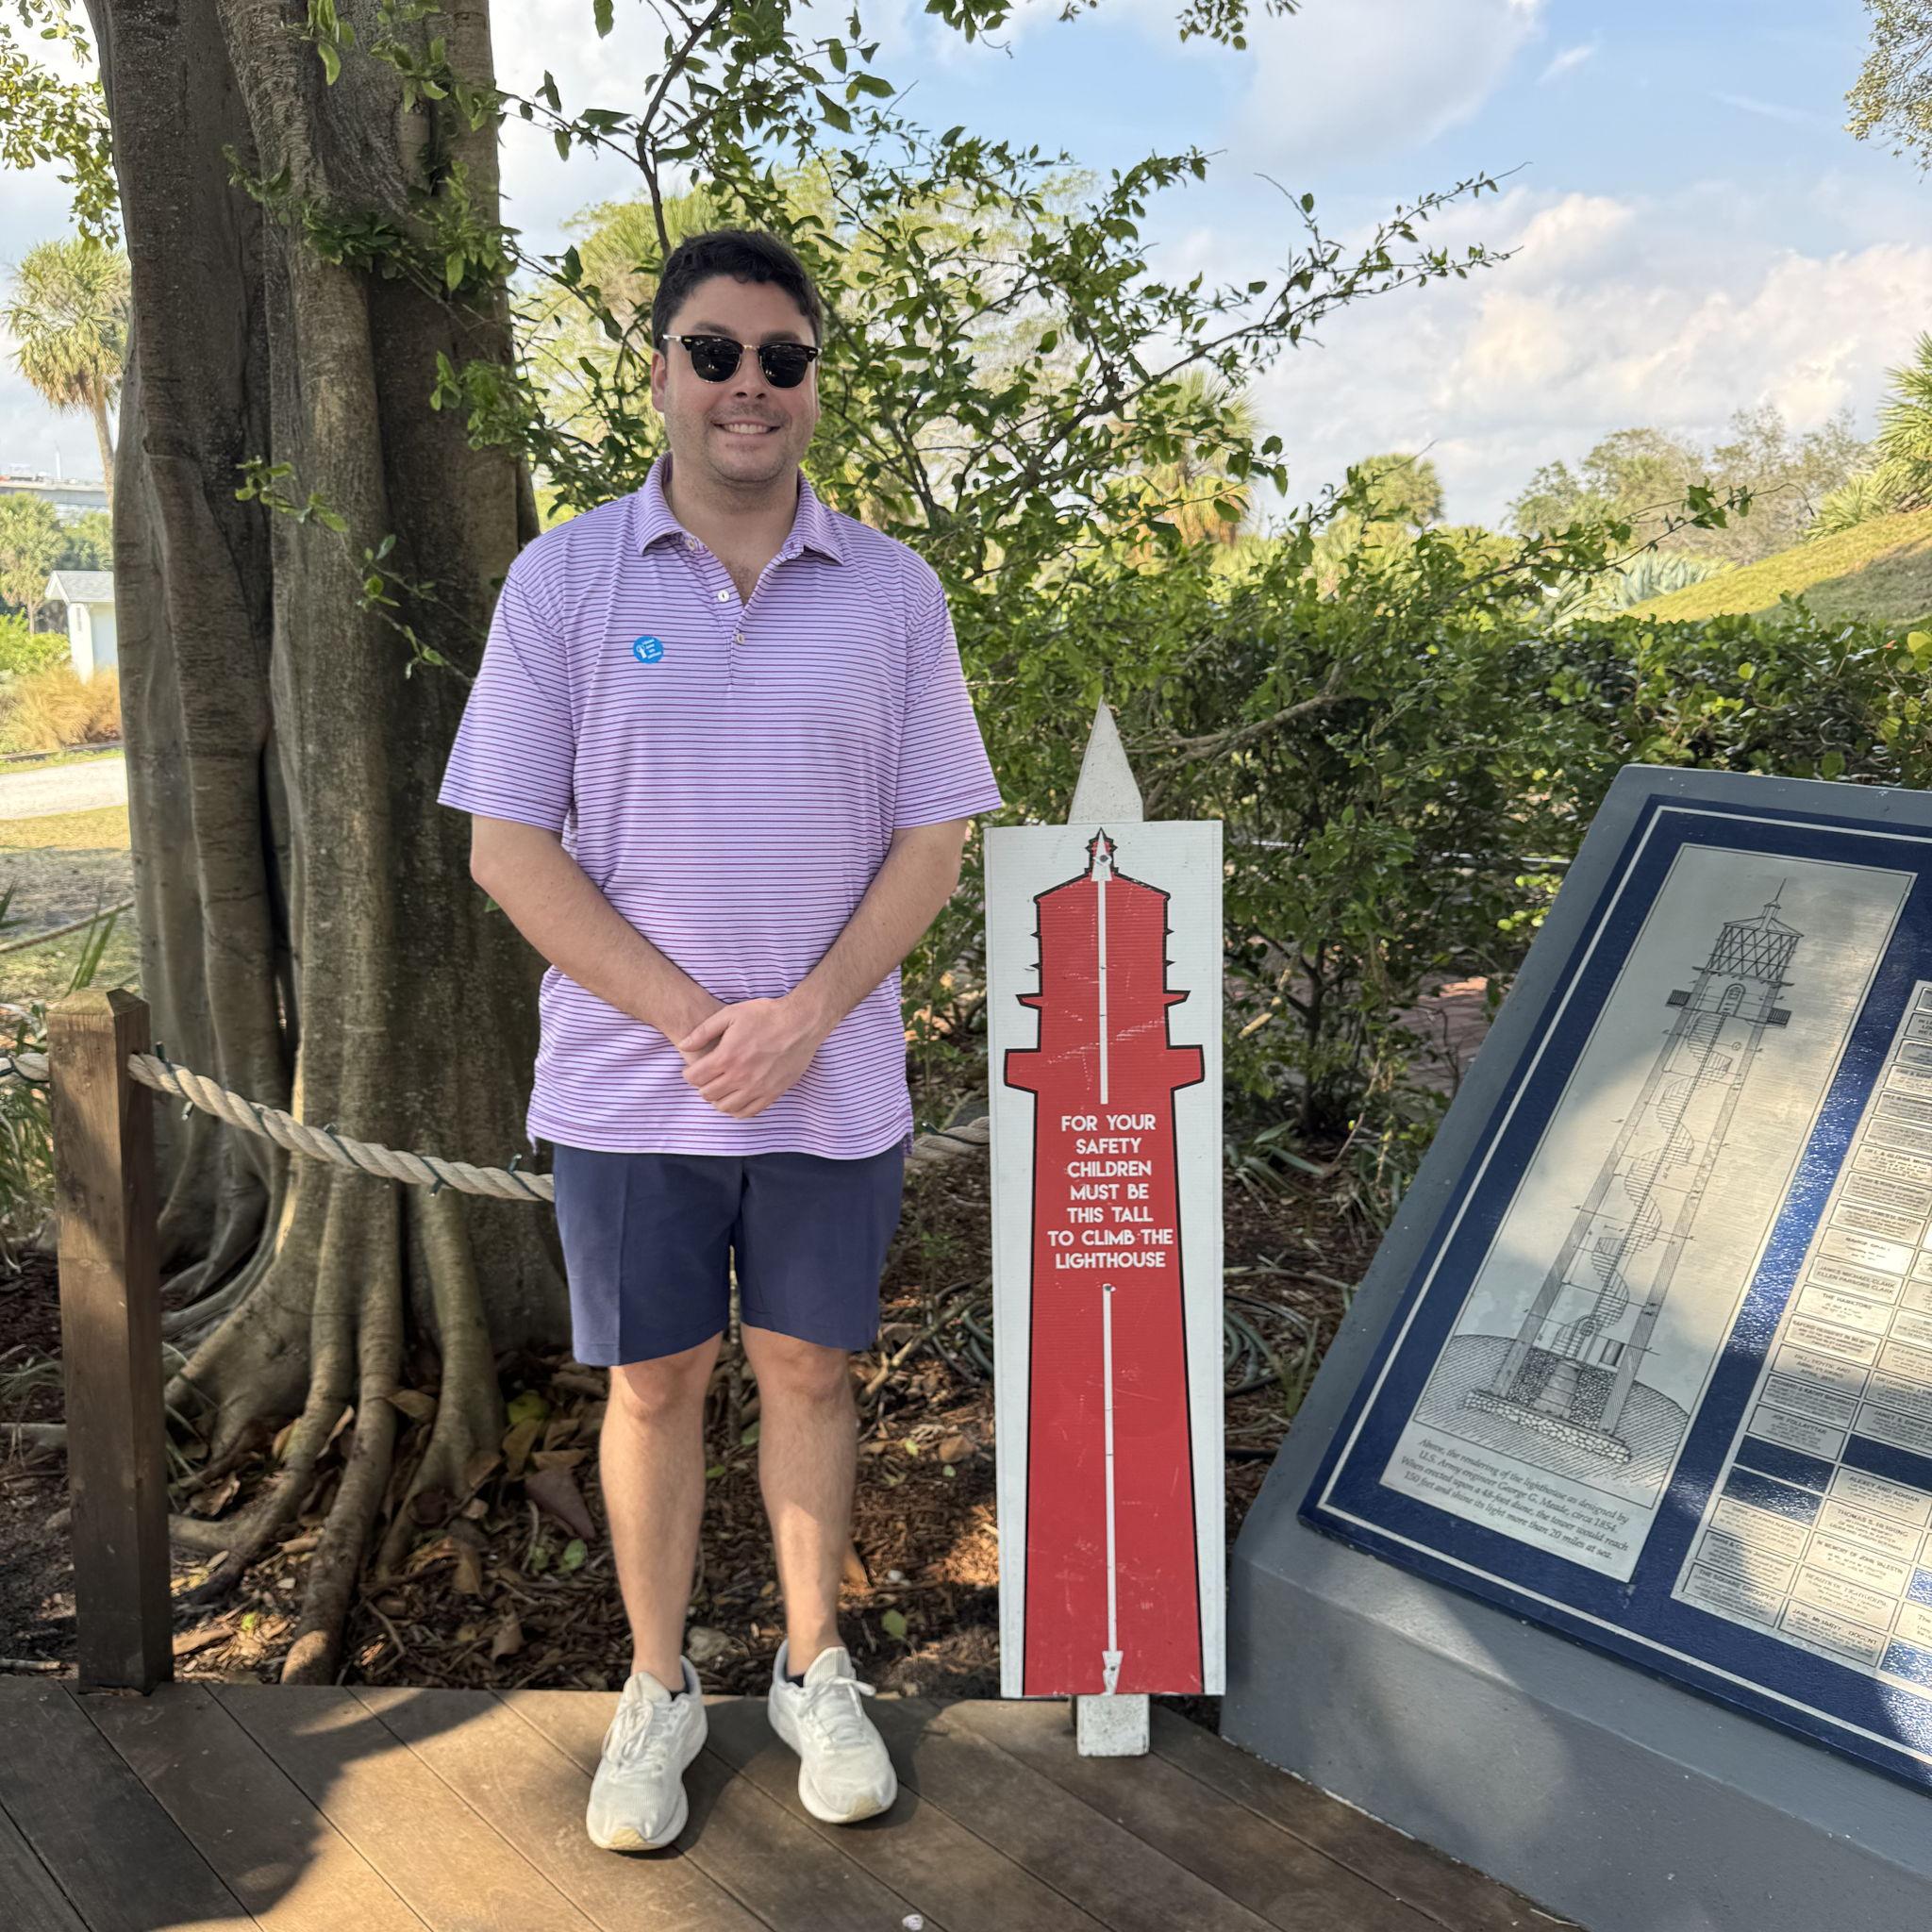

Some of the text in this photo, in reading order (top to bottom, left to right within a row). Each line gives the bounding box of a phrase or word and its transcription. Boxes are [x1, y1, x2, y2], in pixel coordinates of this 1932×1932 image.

[1061, 1114, 1156, 1131] FOR YOUR
[1076, 1138, 1141, 1154] SAFETY
[1067, 1160, 1152, 1177] CHILDREN
[1071, 1184, 1149, 1200] MUST BE
[1067, 1207, 1154, 1223] THIS TALL
[1048, 1229, 1173, 1246] TO CLIMB THE
[1056, 1252, 1166, 1269] LIGHTHOUSE
[1871, 1285, 1893, 1293] CLARK
[1872, 1279, 1894, 1288] CLARK
[1437, 1458, 1461, 1474] Army
[1461, 1470, 1496, 1485] engineer
[1497, 1481, 1525, 1498] George
[1446, 1449, 1459, 1457] the
[1499, 1470, 1511, 1479] of
[1509, 1473, 1523, 1483] the
[1616, 1512, 1629, 1524] by
[1401, 1456, 1424, 1471] When
[1535, 1509, 1549, 1520] the
[1575, 1526, 1604, 1541] would
[1605, 1538, 1628, 1551] reach
[1434, 1485, 1452, 1494] and
[1485, 1503, 1506, 1516] light
[1506, 1513, 1527, 1525] more
[1528, 1521, 1548, 1534] than
[1548, 1528, 1561, 1539] 20
[1561, 1535, 1584, 1548] miles
